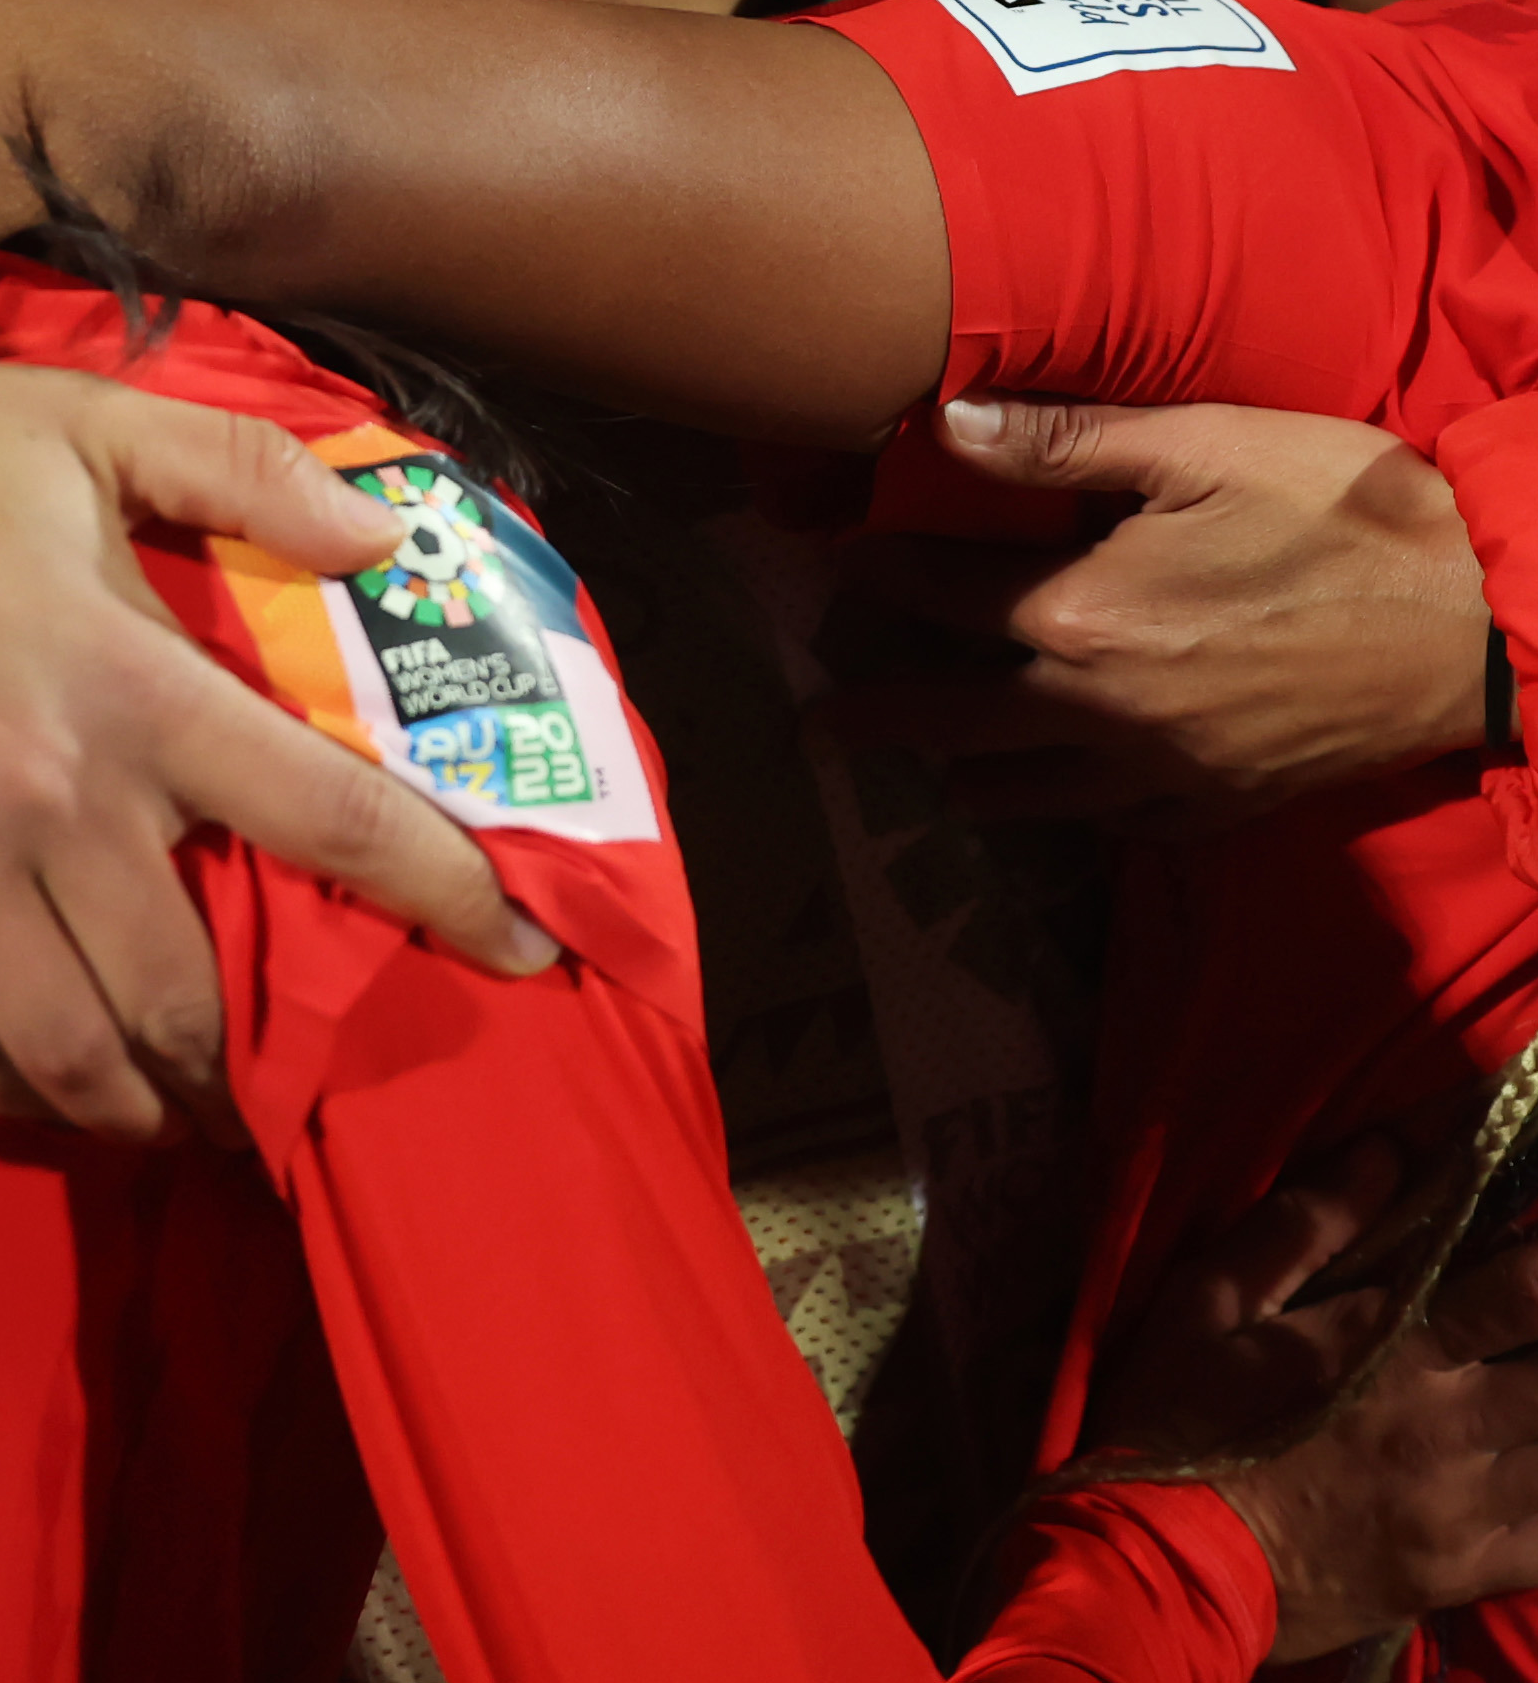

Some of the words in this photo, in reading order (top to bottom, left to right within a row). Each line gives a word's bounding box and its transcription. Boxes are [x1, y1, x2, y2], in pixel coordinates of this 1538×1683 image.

[380, 637, 452, 674] FIFA
[394, 652, 511, 693] WOMEN'S
[400, 680, 491, 717] WORLD
[489, 672, 537, 701] CUP
